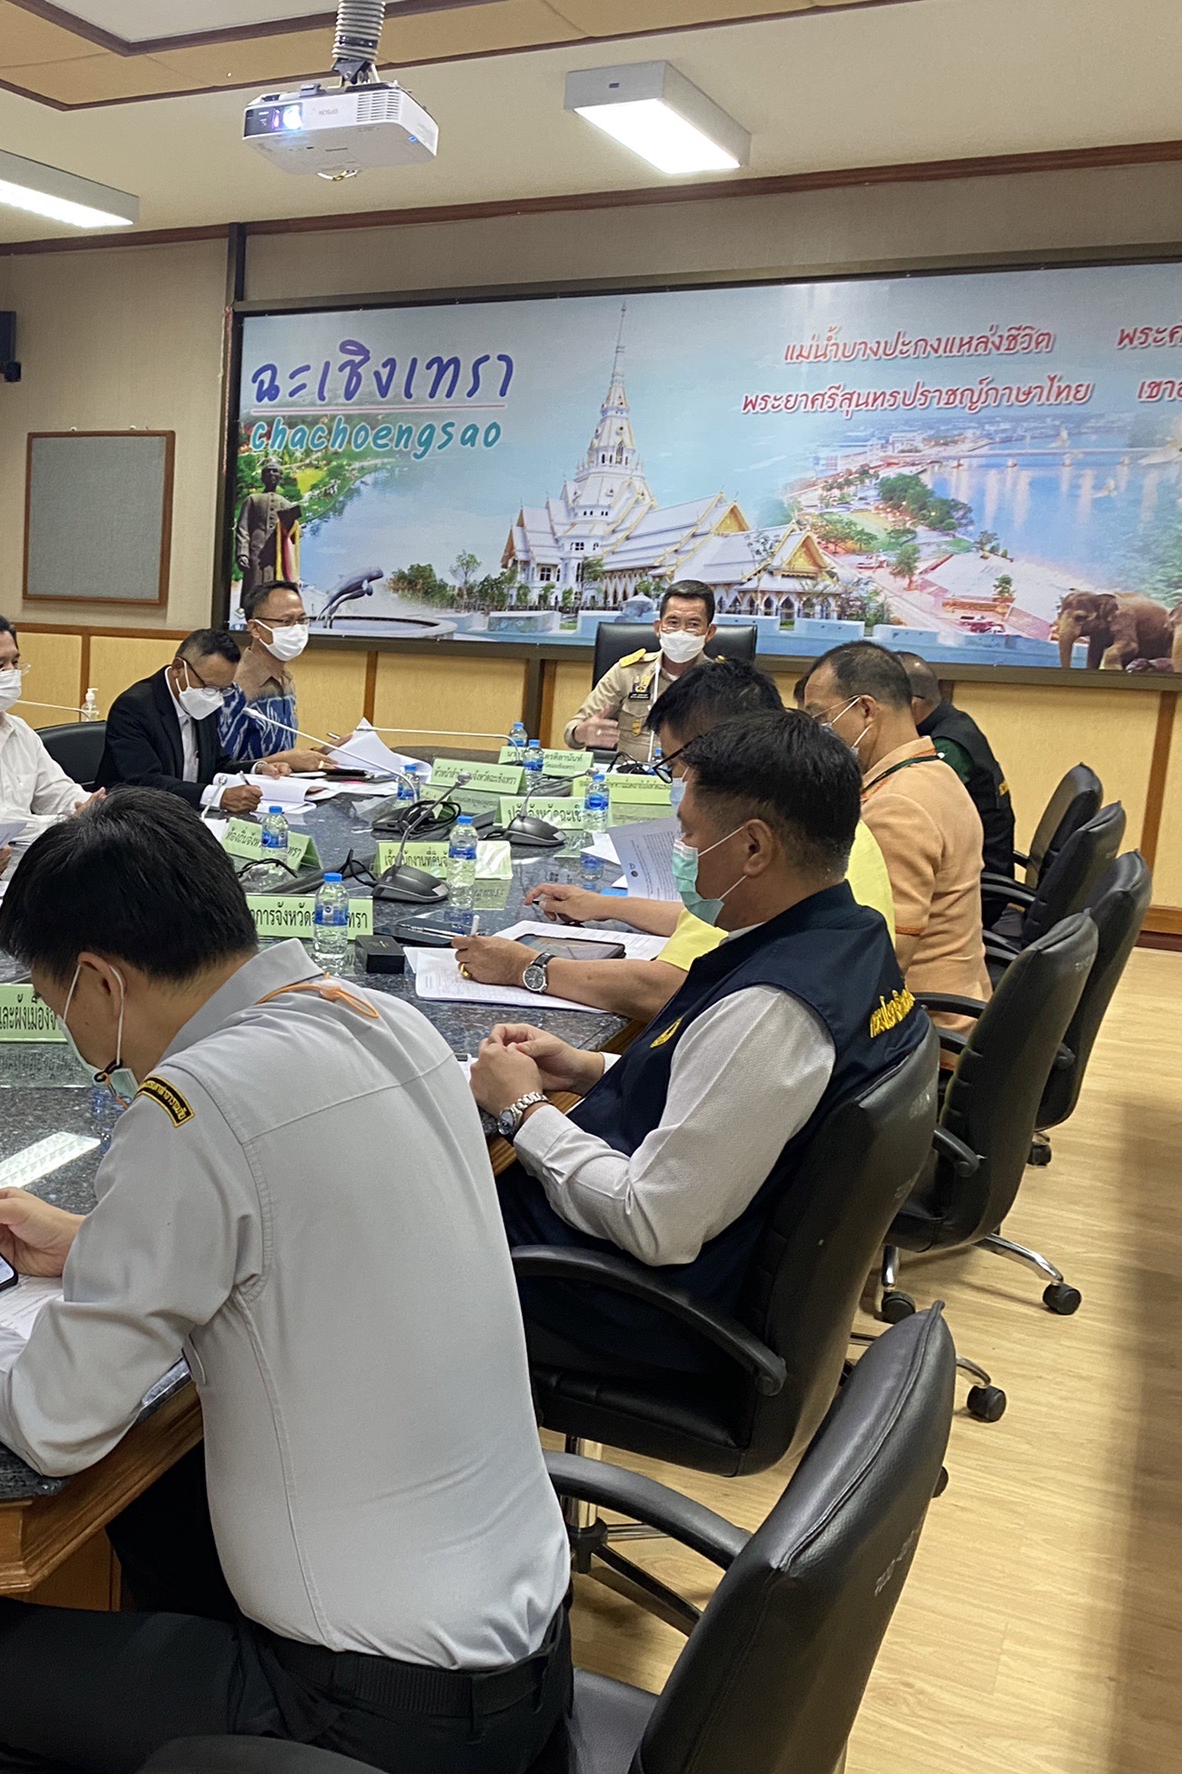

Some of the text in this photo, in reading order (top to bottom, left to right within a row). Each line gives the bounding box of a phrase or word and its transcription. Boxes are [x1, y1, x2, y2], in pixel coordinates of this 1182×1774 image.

[784, 325, 1054, 364] แม่น้ำบางปะกงแหล่งชีวิต
[251, 339, 514, 403] ฉะเชิงเทรา
[741, 375, 1093, 418] พระยาศรีสุนทรปราชญ์ภาษาไทย
